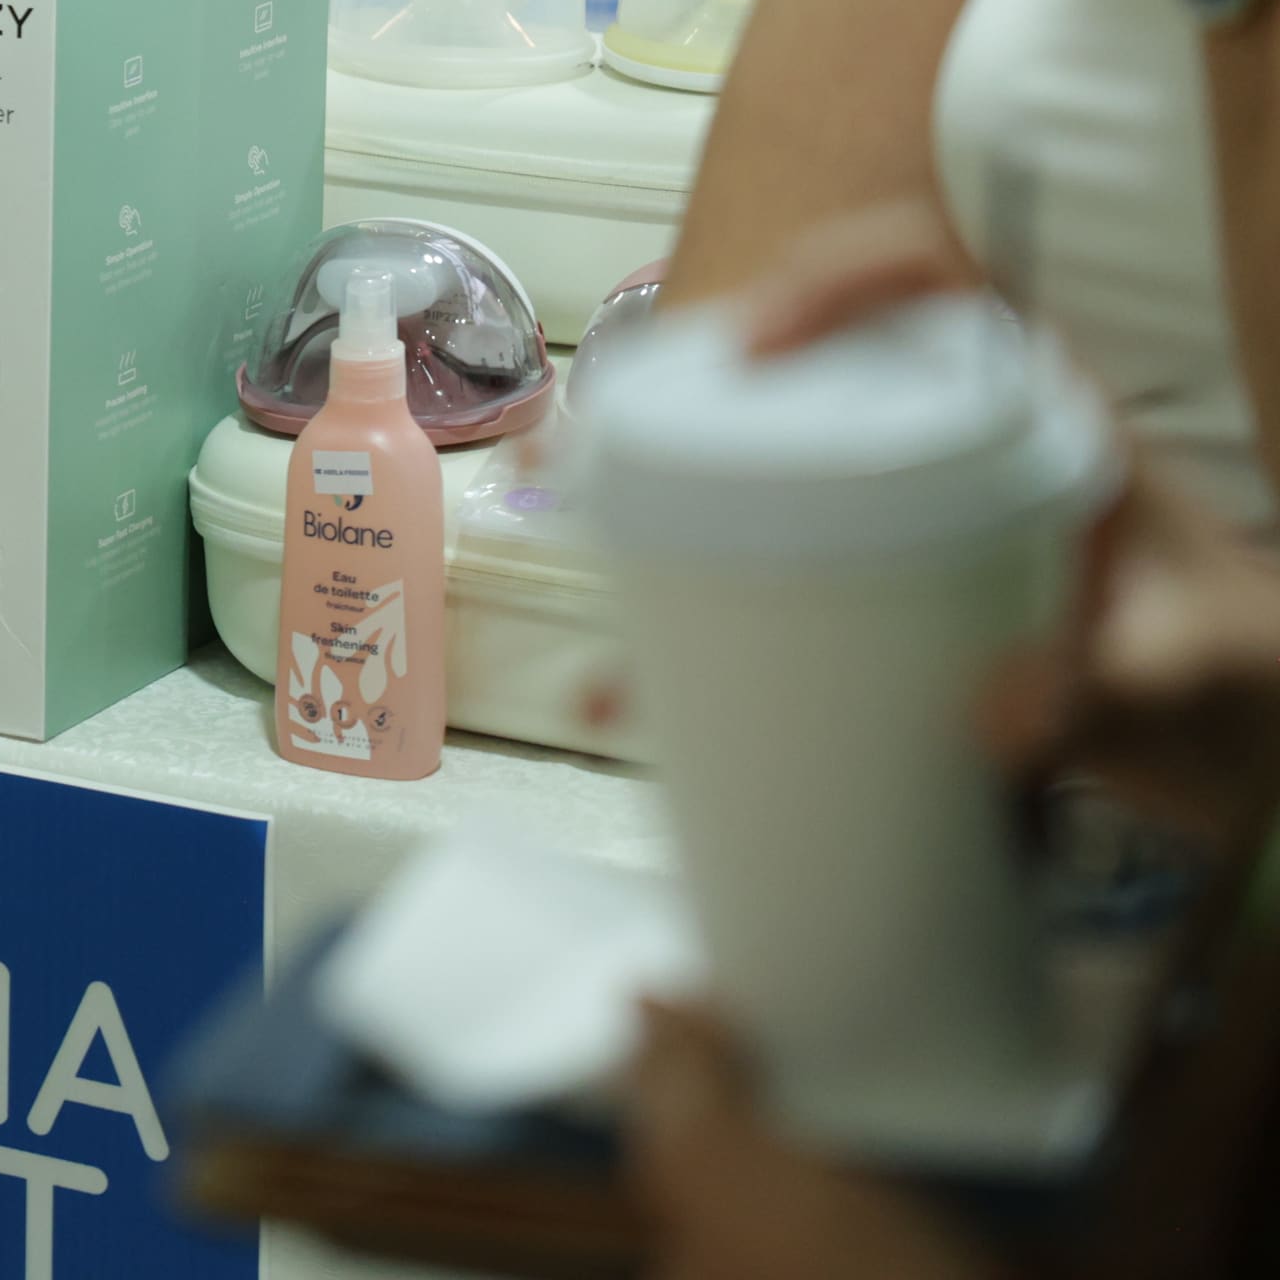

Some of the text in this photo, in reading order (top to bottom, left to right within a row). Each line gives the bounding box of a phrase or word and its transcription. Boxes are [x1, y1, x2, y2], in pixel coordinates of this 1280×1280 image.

[303, 509, 393, 549] Biolane
[332, 571, 357, 584] Eau
[313, 584, 379, 602] de toilette
[330, 622, 357, 635] Skin
[311, 632, 379, 656] freshening
